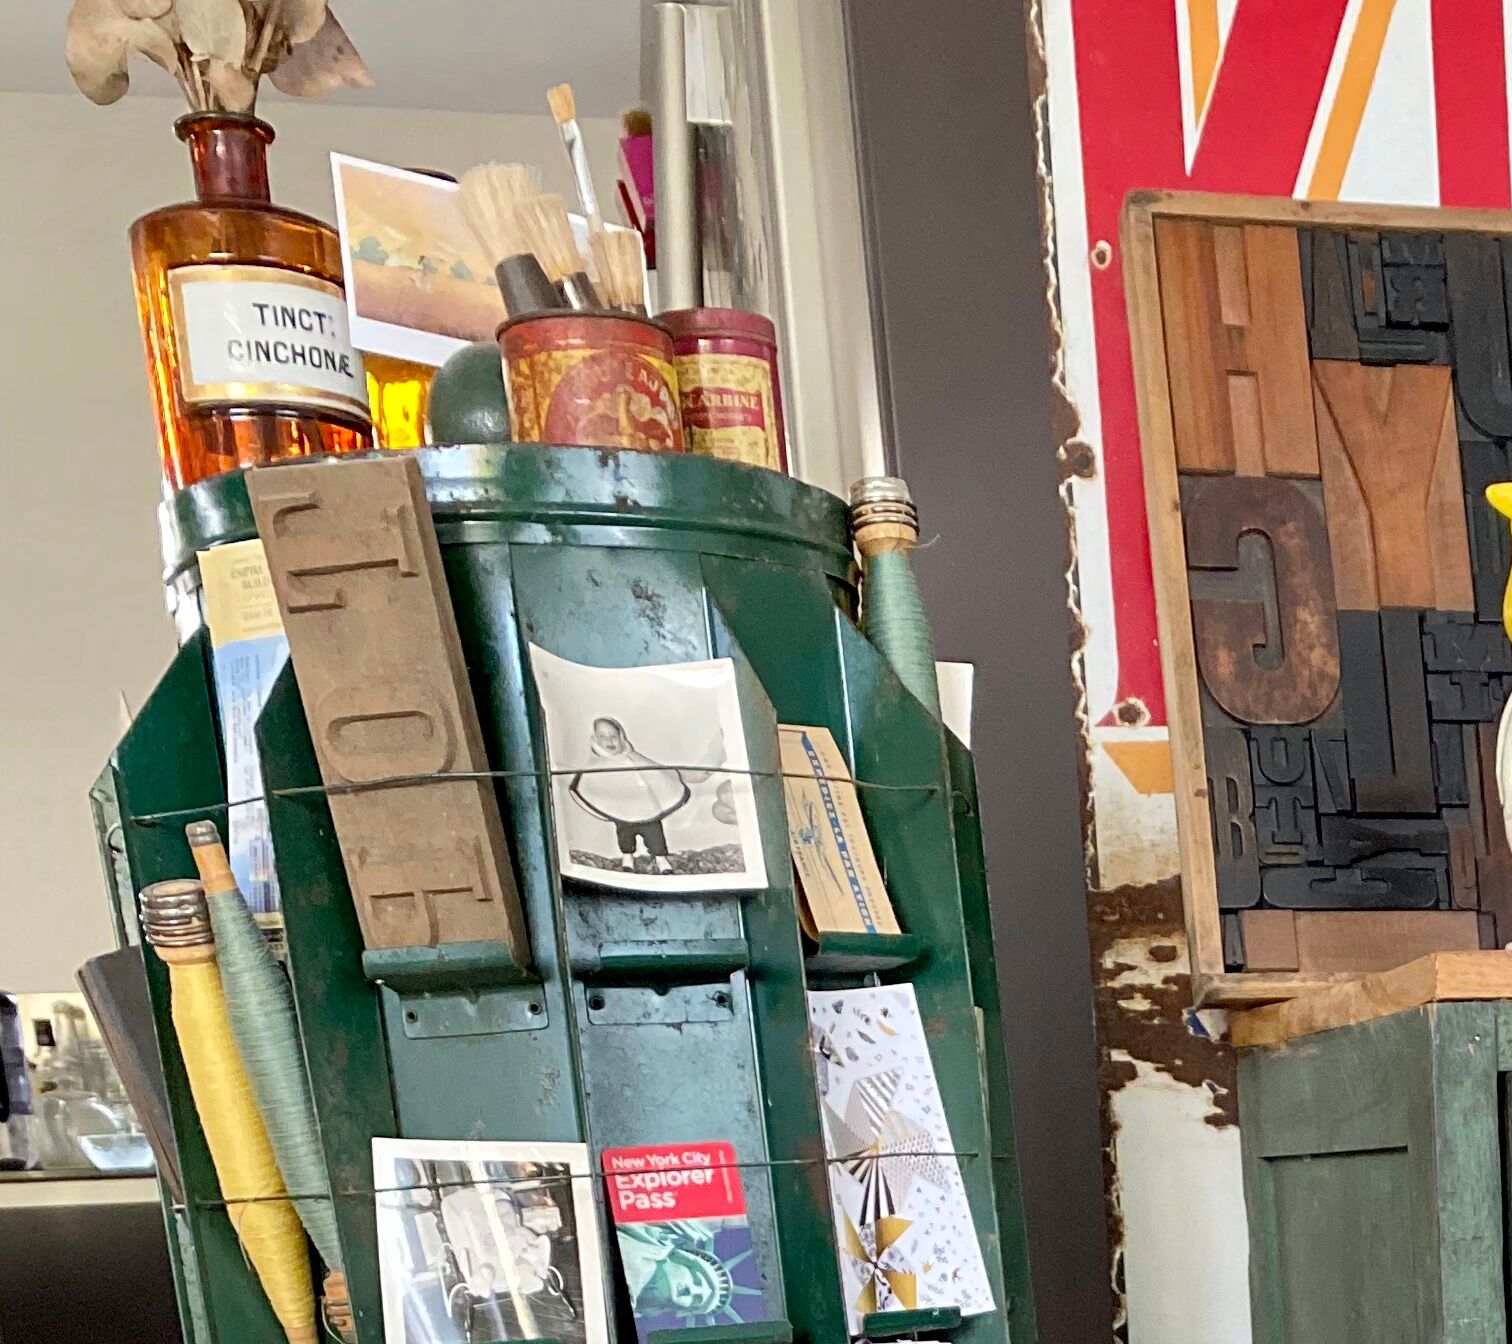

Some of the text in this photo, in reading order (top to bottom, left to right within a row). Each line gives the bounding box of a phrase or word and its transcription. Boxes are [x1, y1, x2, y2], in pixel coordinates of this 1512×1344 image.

[611, 1150, 711, 1171] New York City
[614, 1169, 714, 1192] Explorer
[618, 1188, 677, 1211] Pass
